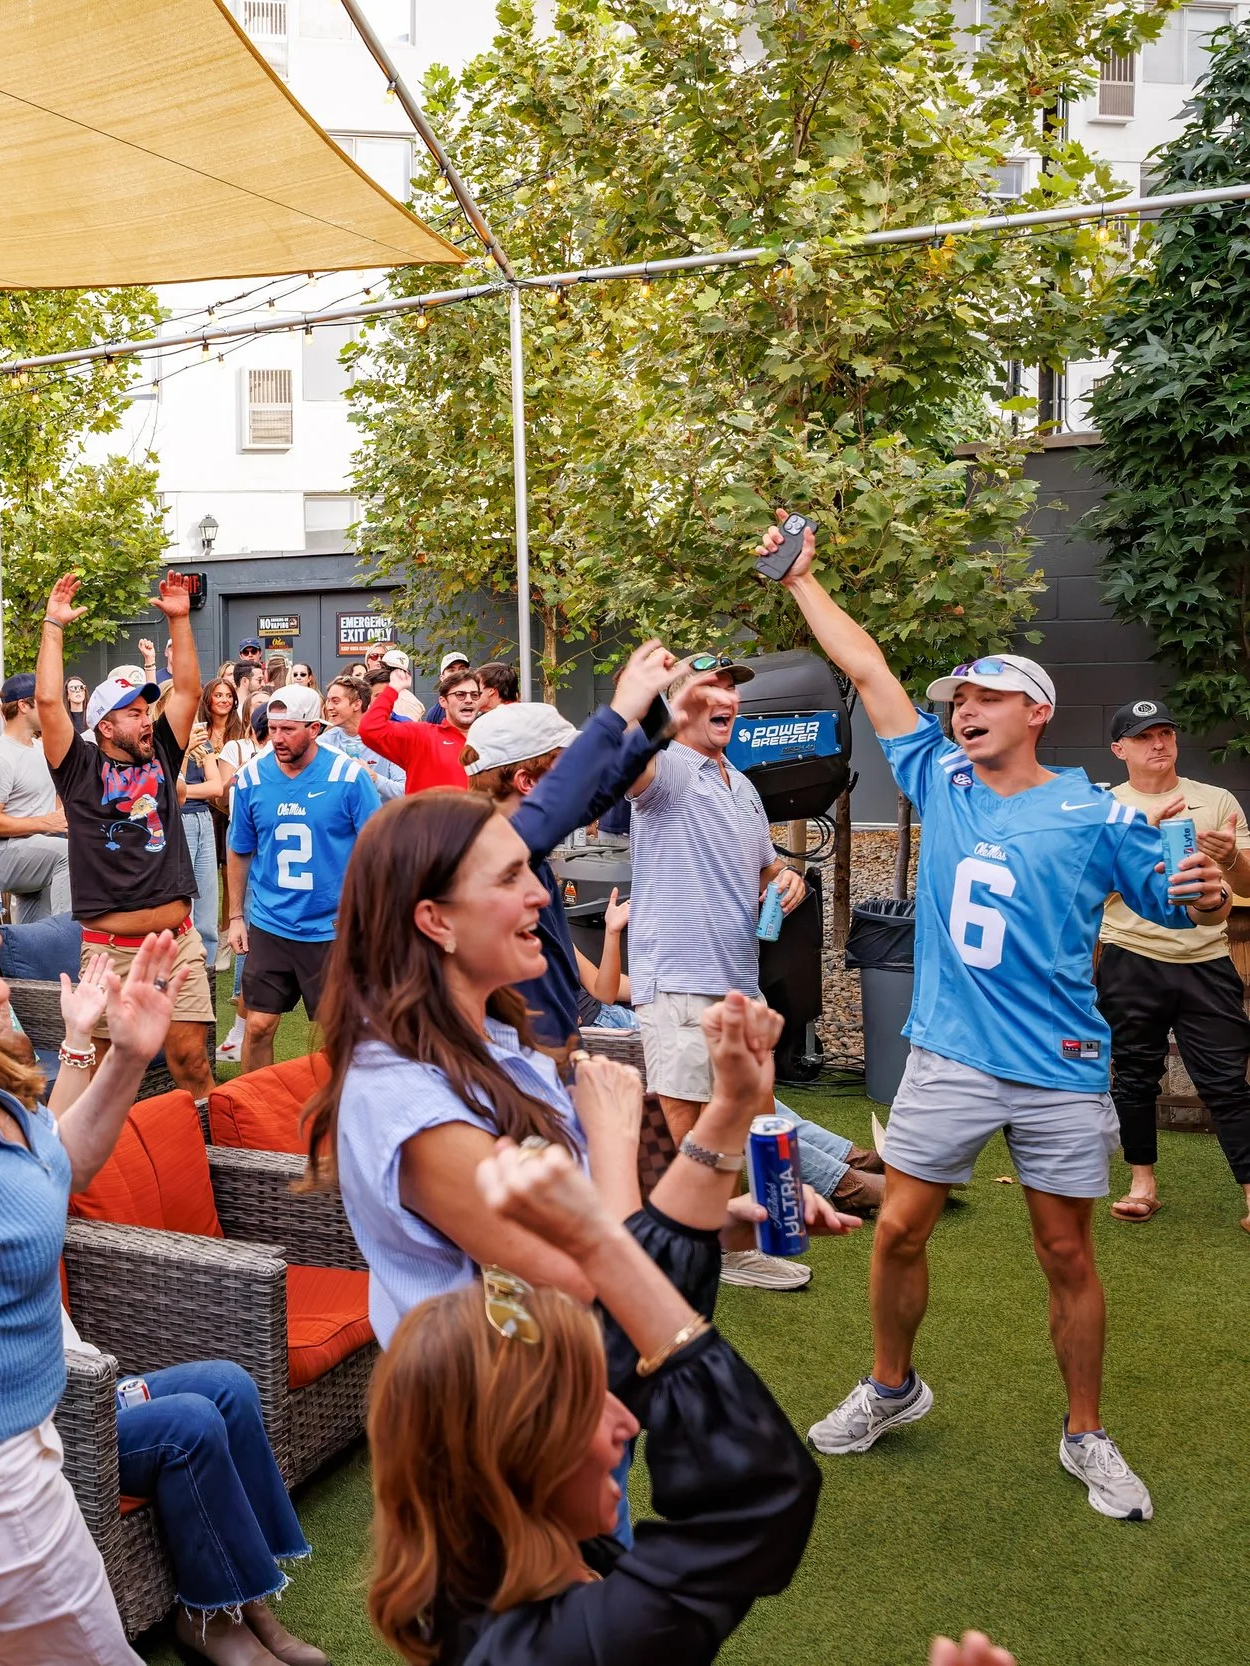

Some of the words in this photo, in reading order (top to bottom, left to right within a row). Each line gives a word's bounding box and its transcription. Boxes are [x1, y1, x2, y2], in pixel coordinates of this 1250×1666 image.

[260, 618, 270, 630] NO
[341, 615, 393, 629] EMERGENCY
[341, 628, 365, 643] EXIT
[367, 627, 392, 642] ONLY
[752, 721, 820, 739] POWER
[751, 732, 818, 748] BREEZER
[1183, 827, 1193, 848] Lyte
[274, 822, 314, 890] 2
[973, 841, 989, 857] Ole
[988, 844, 1007, 861] Miss
[949, 856, 1017, 970] 6
[779, 1163, 801, 1239] ULTRA
